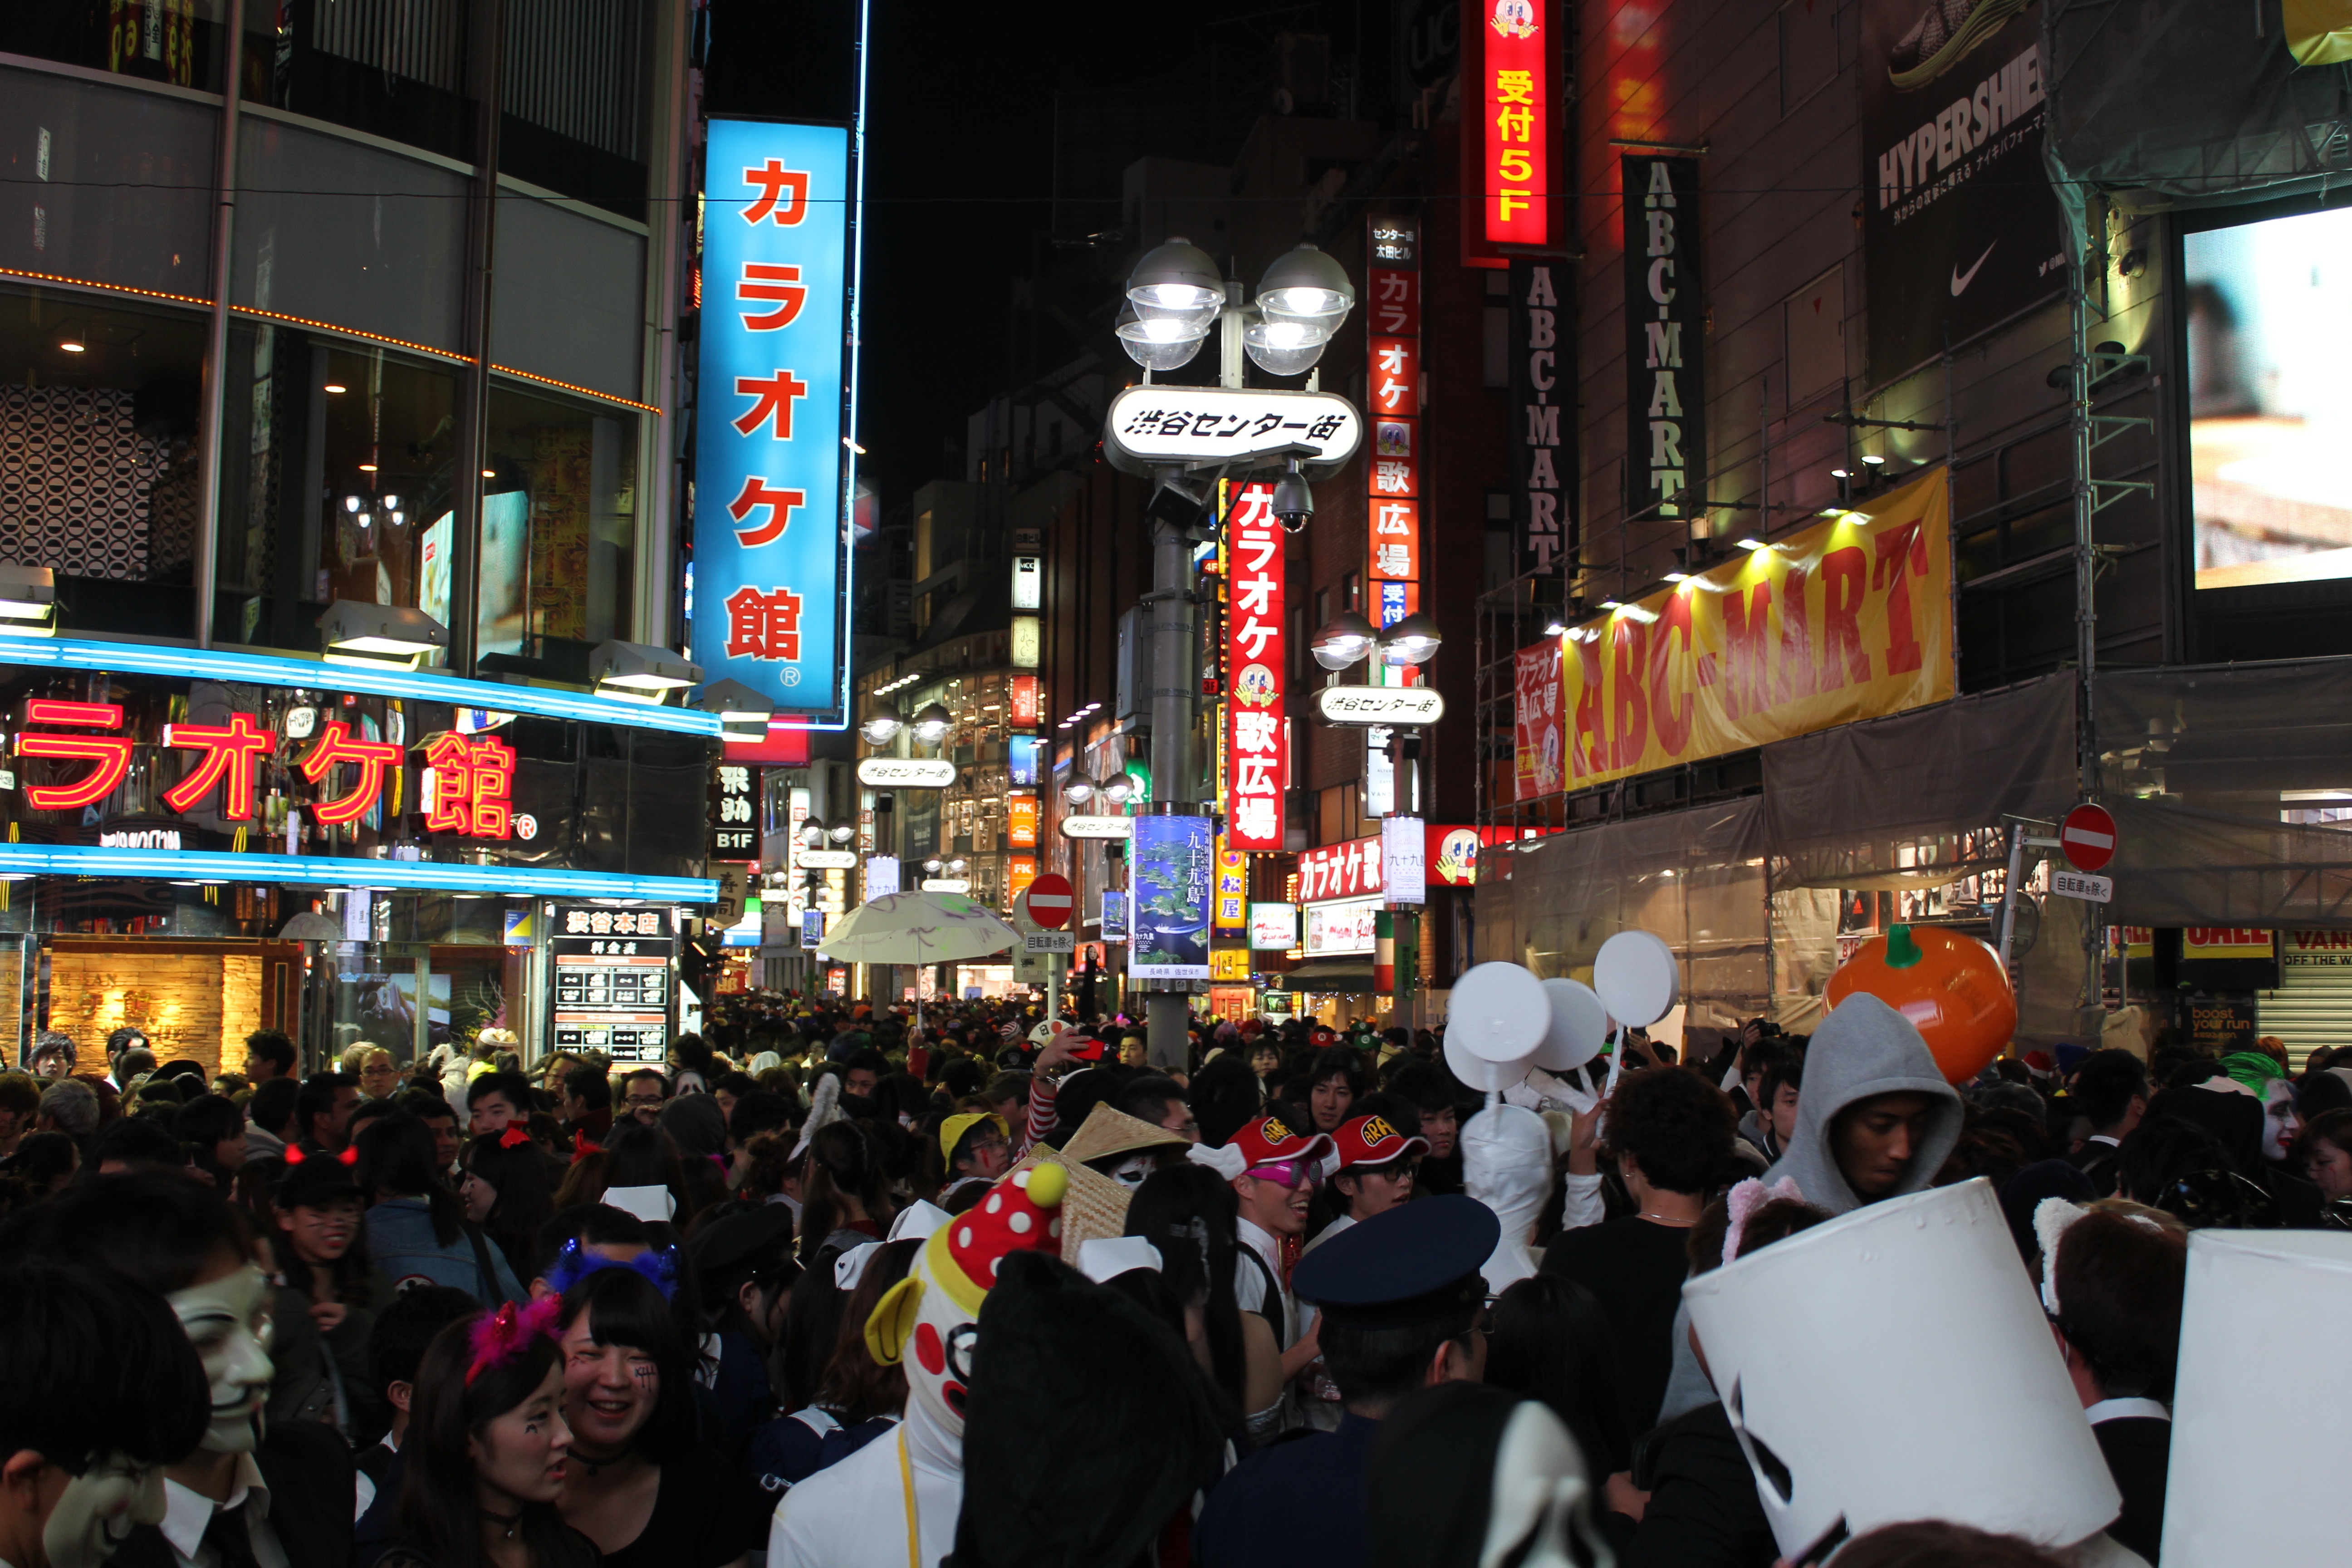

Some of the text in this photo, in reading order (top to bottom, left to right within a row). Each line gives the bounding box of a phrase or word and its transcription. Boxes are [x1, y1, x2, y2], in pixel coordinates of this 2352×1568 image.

[1496, 69, 1534, 222] 受付5F
[1373, 228, 1414, 242] センター街
[1376, 244, 1411, 260] 太田ビル
[1644, 162, 1685, 516] ABC-MART
[723, 157, 810, 664] カラオケ館
[1123, 409, 1347, 441] 渋谷センター街
[1526, 267, 1560, 574] ABC-MART
[1205, 563, 1219, 572] 4F
[1572, 517, 1929, 779] ABC-MART
[1326, 696, 1436, 713] 渋谷センター街
[14, 699, 516, 840] ラオケ館
[863, 766, 951, 779] 渋谷センター街
[1014, 803, 1033, 813] FK
[716, 833, 753, 848] B1F
[1014, 864, 1031, 874] FK
[1186, 831, 1201, 905] 九十九島
[1300, 838, 1382, 900] カラオケ歌
[1220, 875, 1241, 918] 松屋
[2057, 876, 2108, 898] 自転車を除く
[566, 910, 660, 935] 渋谷本店
[590, 941, 637, 955] 料金表
[1027, 936, 1072, 949] 自転車を除く
[2293, 931, 2352, 950] VAN
[2284, 955, 2352, 965] OFF THE W
[2192, 1008, 2234, 1019] boost
[2192, 1019, 2250, 1031] your run
[1364, 1117, 1400, 1145] ARA
